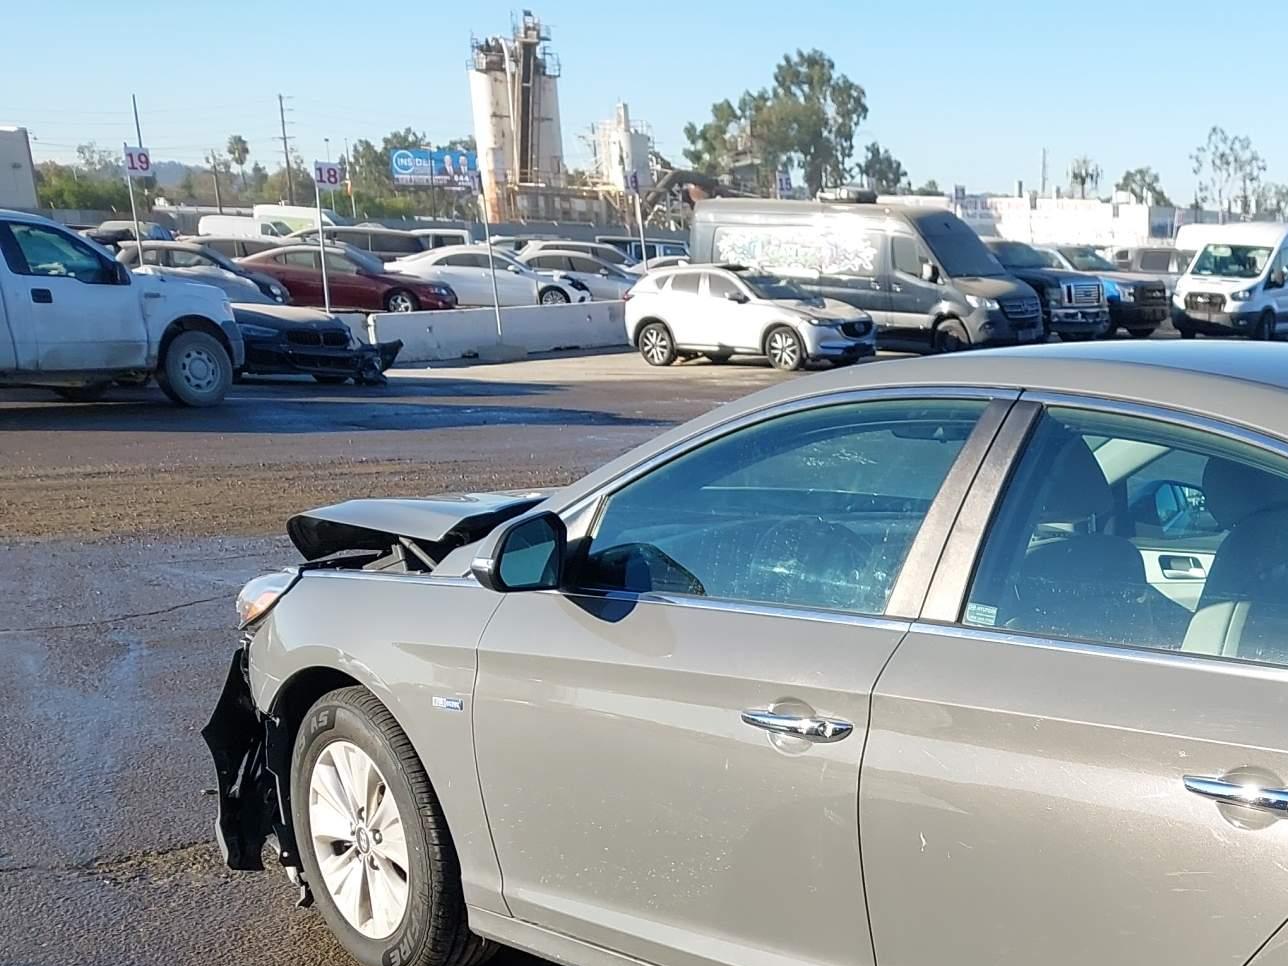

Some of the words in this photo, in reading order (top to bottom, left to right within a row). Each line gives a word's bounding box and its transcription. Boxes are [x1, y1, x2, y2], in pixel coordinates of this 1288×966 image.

[127, 152, 149, 171] 19
[316, 167, 338, 184] 18
[779, 177, 792, 191] 15
